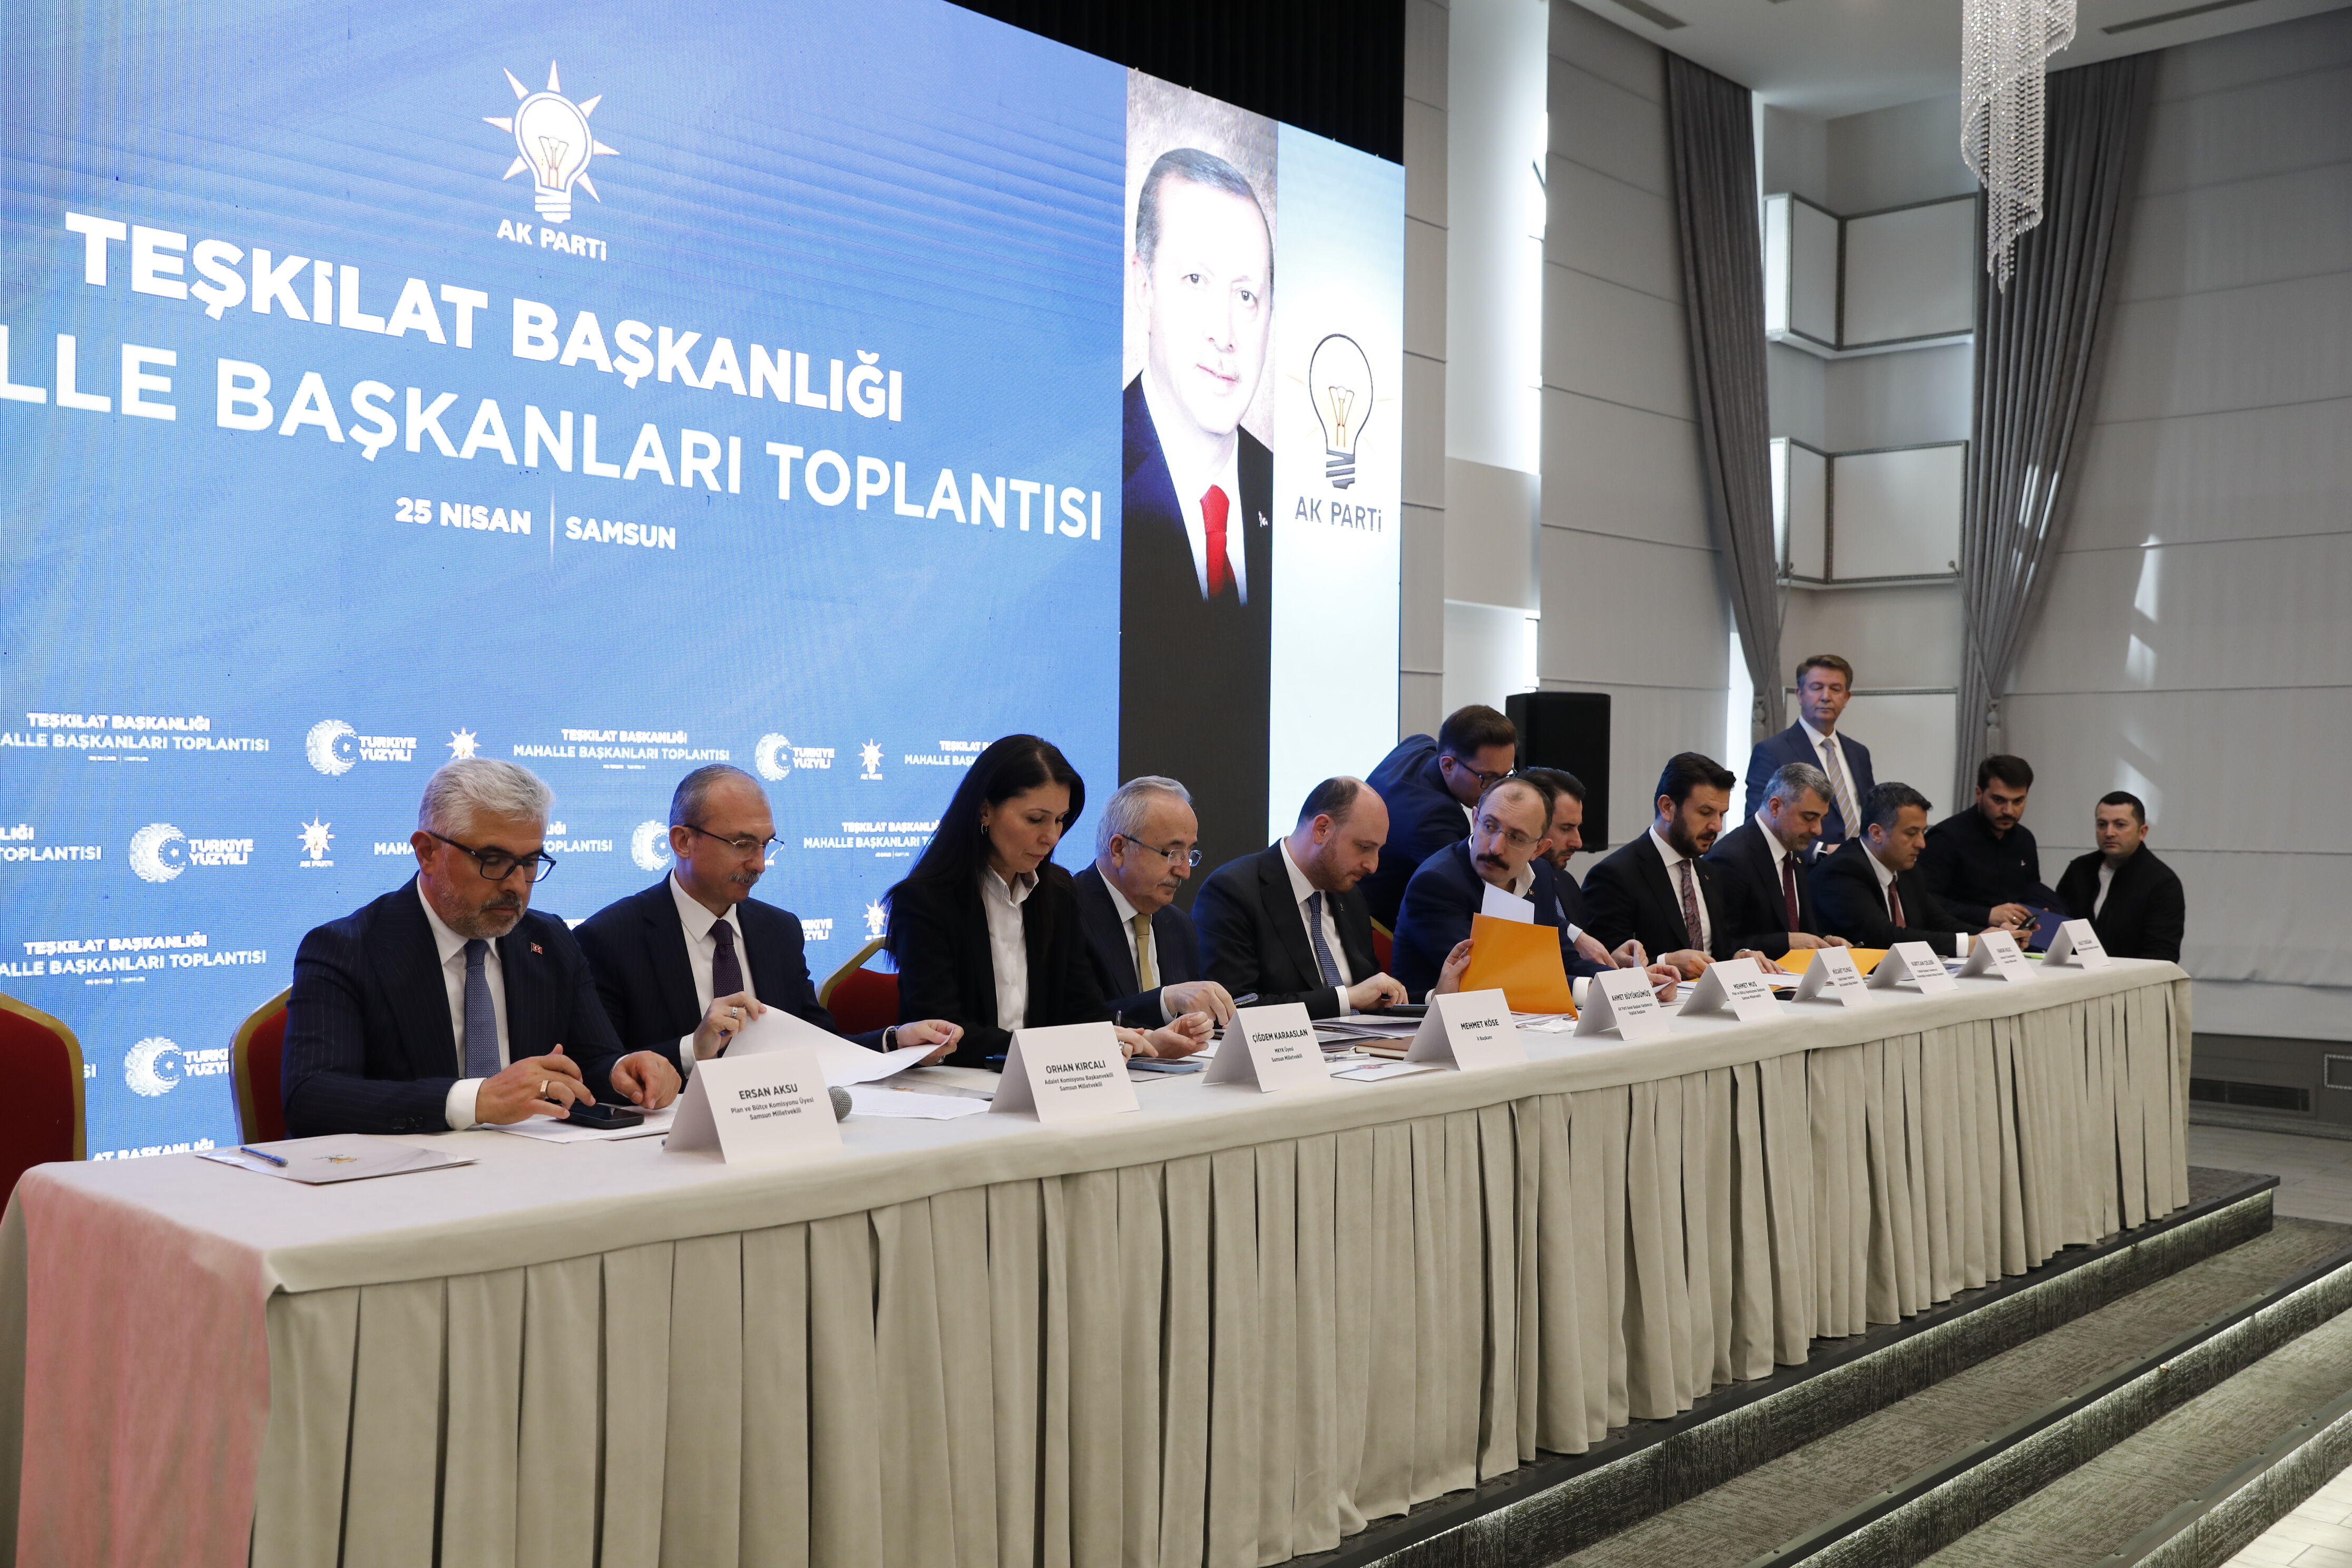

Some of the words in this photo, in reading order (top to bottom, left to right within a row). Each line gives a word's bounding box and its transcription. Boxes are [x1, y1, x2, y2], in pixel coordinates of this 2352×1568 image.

[497, 219, 532, 244] AK
[66, 212, 488, 349] TEŞKİLAT
[513, 297, 902, 423] BAŞKANLIĞI
[217, 358, 740, 495] BAŞKANLARI
[766, 441, 1102, 541] TOPLANTISI
[395, 497, 432, 524] 25
[1295, 496, 1322, 523] AK
[565, 516, 676, 550] SAMSUN
[54, 734, 168, 750] BAŞKANLARI
[172, 737, 269, 751] TOPLANTISI
[513, 745, 575, 758] MAHALLE
[579, 747, 659, 760] BAŞKANLARI
[661, 748, 729, 761] TOPLANTISI
[905, 754, 950, 766] MAHALLE
[374, 842, 416, 855] MAHA
[543, 840, 612, 852] OPLANTISI
[803, 837, 854, 848] MAHALLE
[856, 837, 920, 849] BAŞKANLARI
[50, 955, 164, 975] BAŞKANLARI
[170, 949, 266, 968] TOPLANTISI
[1625, 989, 1651, 999] BÜYÜKGÜMÜŞ
[1461, 1020, 1483, 1031] MEHMET
[1485, 1018, 1500, 1027] KÖSE
[1252, 1032, 1274, 1043] ÇİĞDEM
[1273, 1028, 1308, 1041] KARAASLAN
[1046, 1062, 1074, 1074] ORHAN
[1075, 1060, 1106, 1071] KIRCALI
[1060, 1075, 1085, 1084] Komisyonu
[1086, 1072, 1114, 1081] Başkanvekili
[739, 1086, 771, 1100] ERSAN
[773, 1083, 798, 1095] AKSU
[752, 1103, 768, 1112] Bütçe
[769, 1099, 799, 1109] Komisyonu
[799, 1096, 815, 1106] Üyesi
[772, 1106, 801, 1117] Milletvekili
